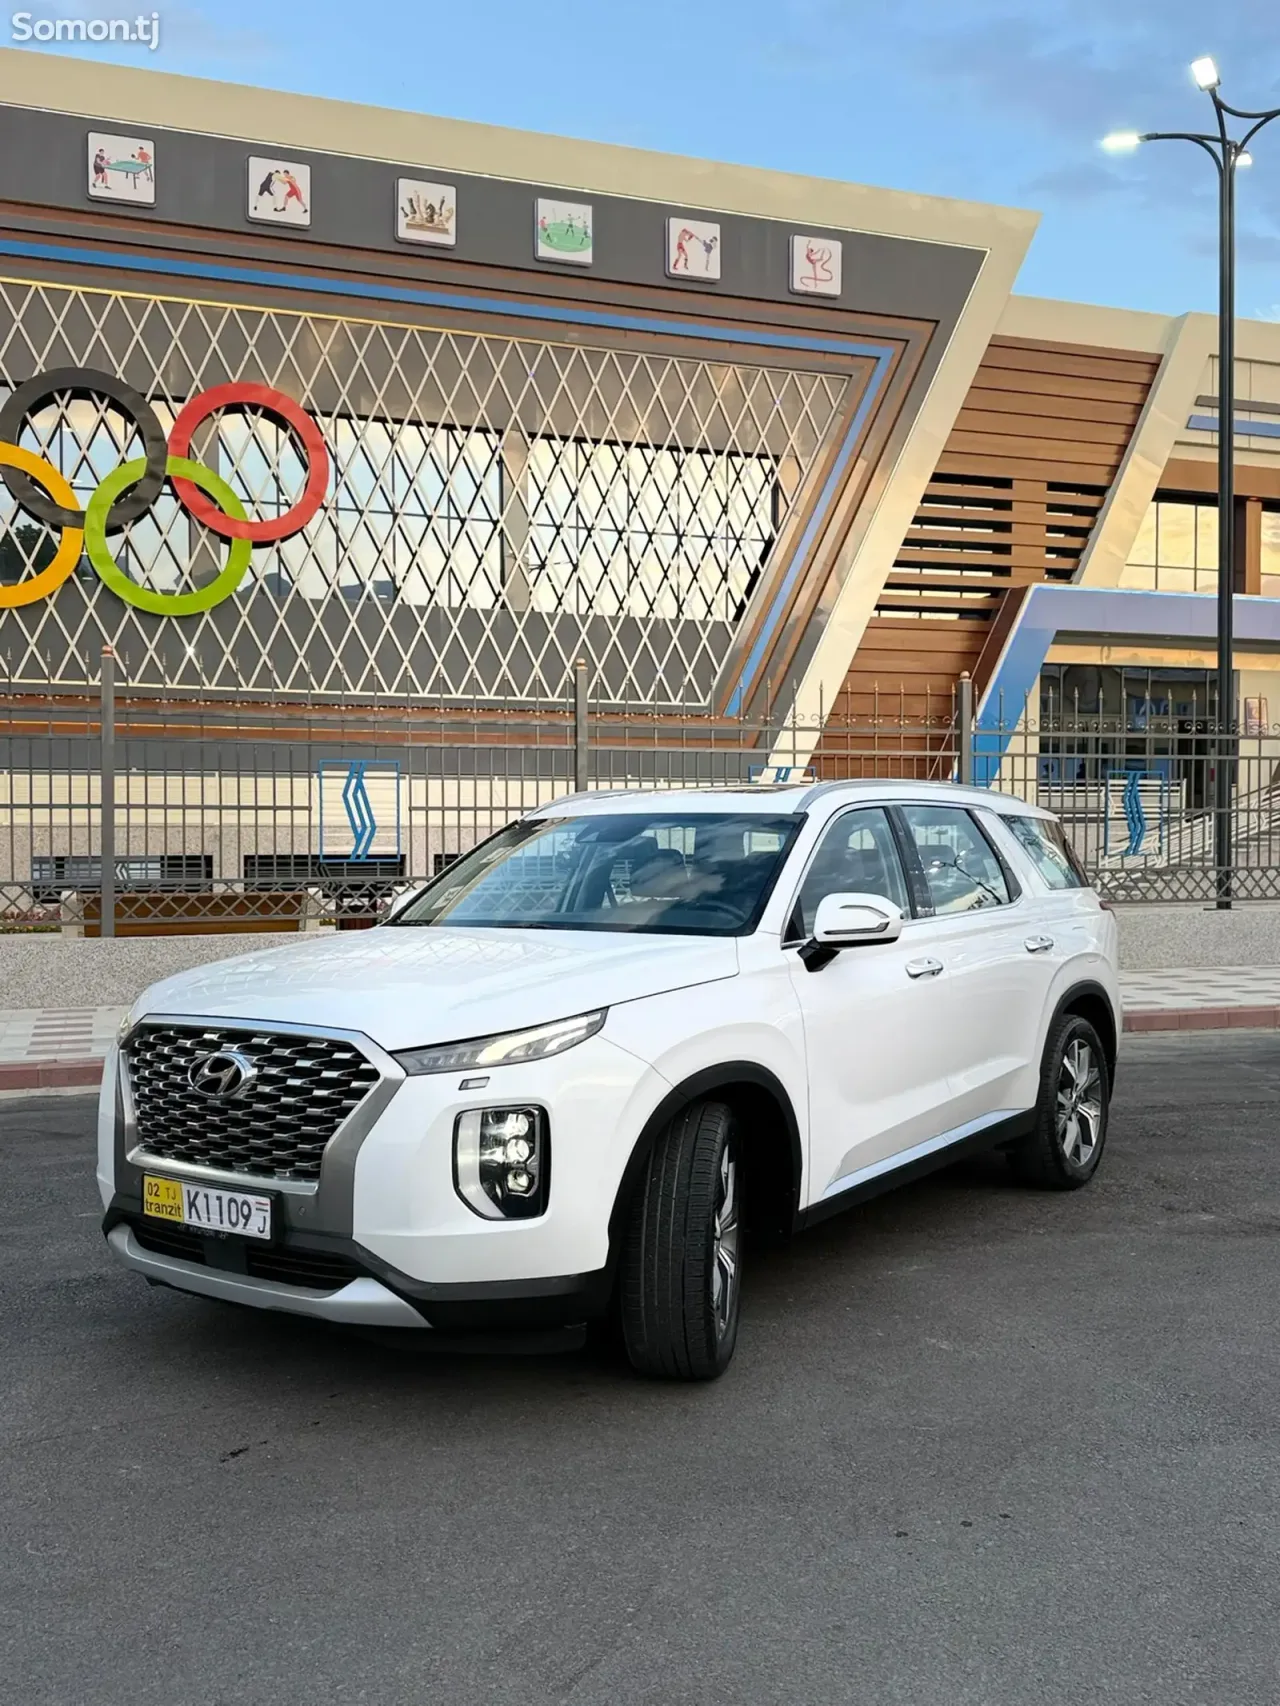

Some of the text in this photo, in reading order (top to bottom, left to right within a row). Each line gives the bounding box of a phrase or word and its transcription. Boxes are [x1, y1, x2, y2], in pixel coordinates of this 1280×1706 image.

[147, 1182, 177, 1201] 02 TJ
[144, 1200, 182, 1218] tranzit
[186, 1189, 253, 1230] K1109
[257, 1215, 267, 1234] J
